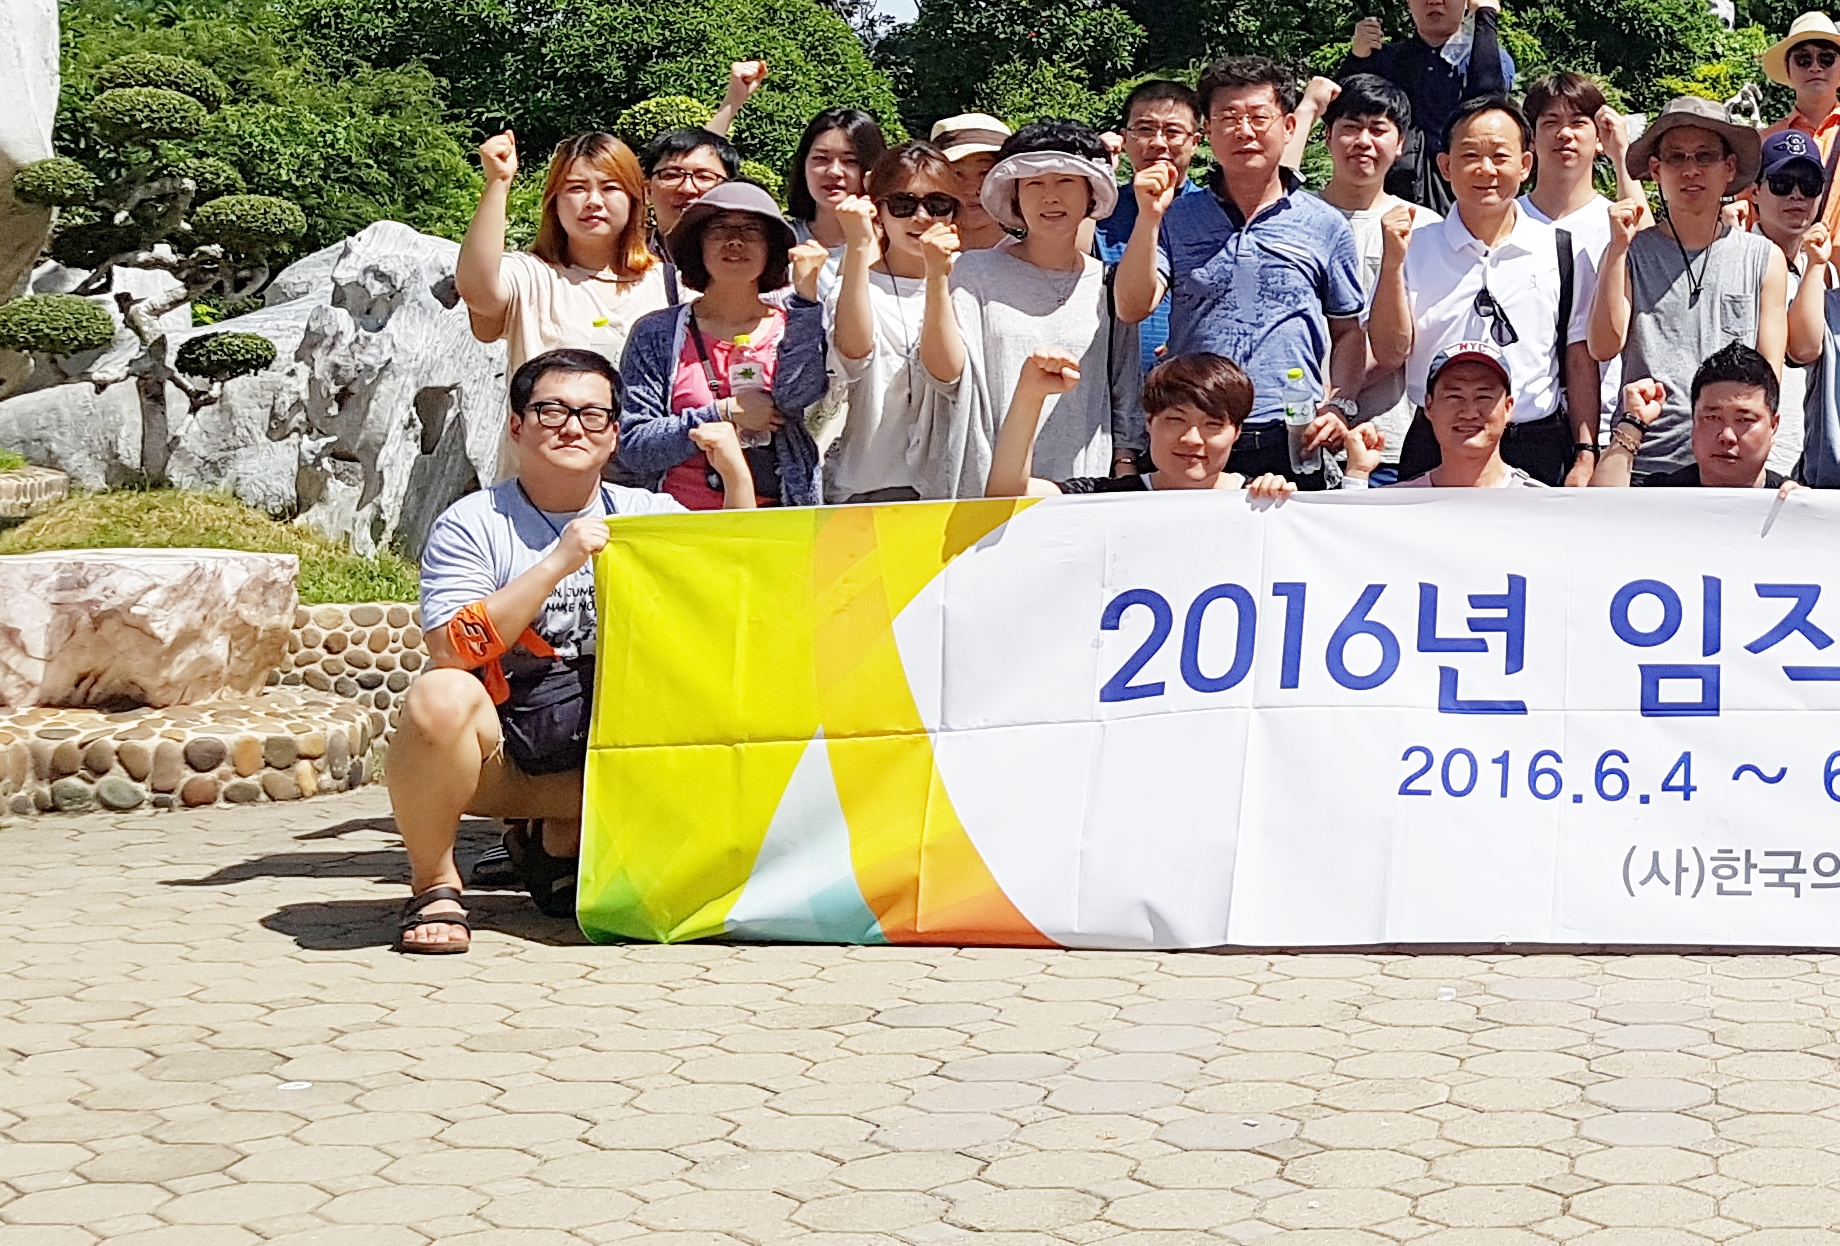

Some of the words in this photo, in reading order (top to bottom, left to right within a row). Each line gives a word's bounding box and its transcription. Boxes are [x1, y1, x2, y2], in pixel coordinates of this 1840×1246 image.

[544, 602, 575, 613] MAKE
[1098, 572, 1529, 716] 2016년
[1396, 744, 1698, 806] 2016.6.4
